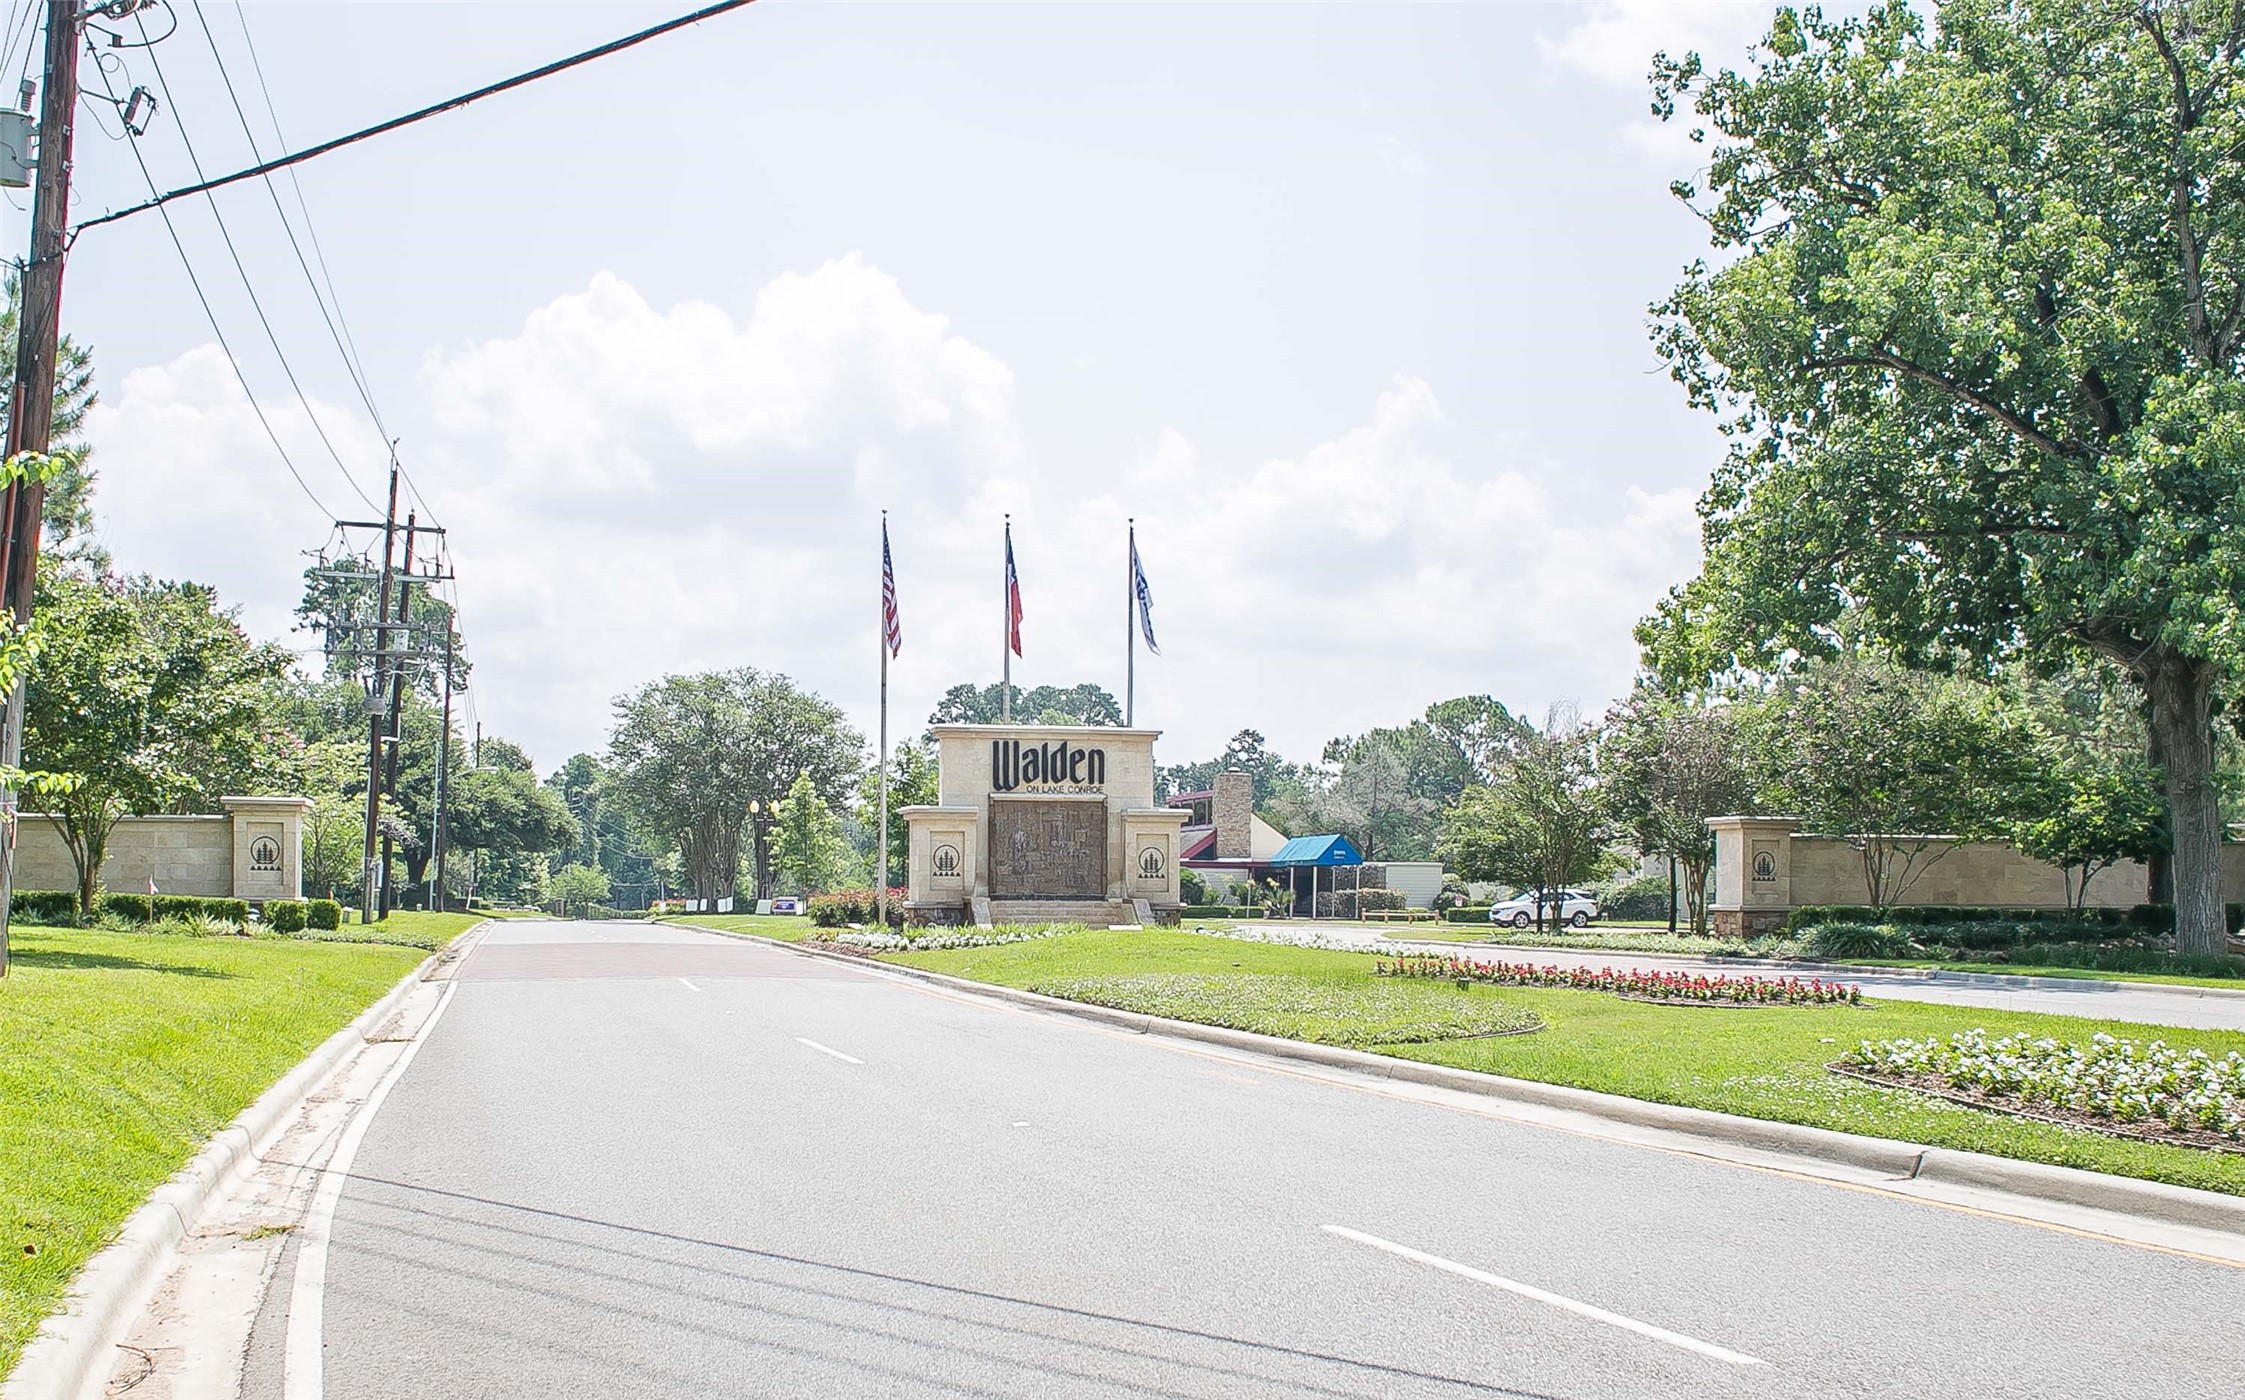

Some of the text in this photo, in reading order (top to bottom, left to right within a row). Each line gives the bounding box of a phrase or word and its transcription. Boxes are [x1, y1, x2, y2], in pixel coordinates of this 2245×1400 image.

[993, 740, 1105, 791] Walden
[1026, 785, 1104, 794] ON LAKE CONROE
